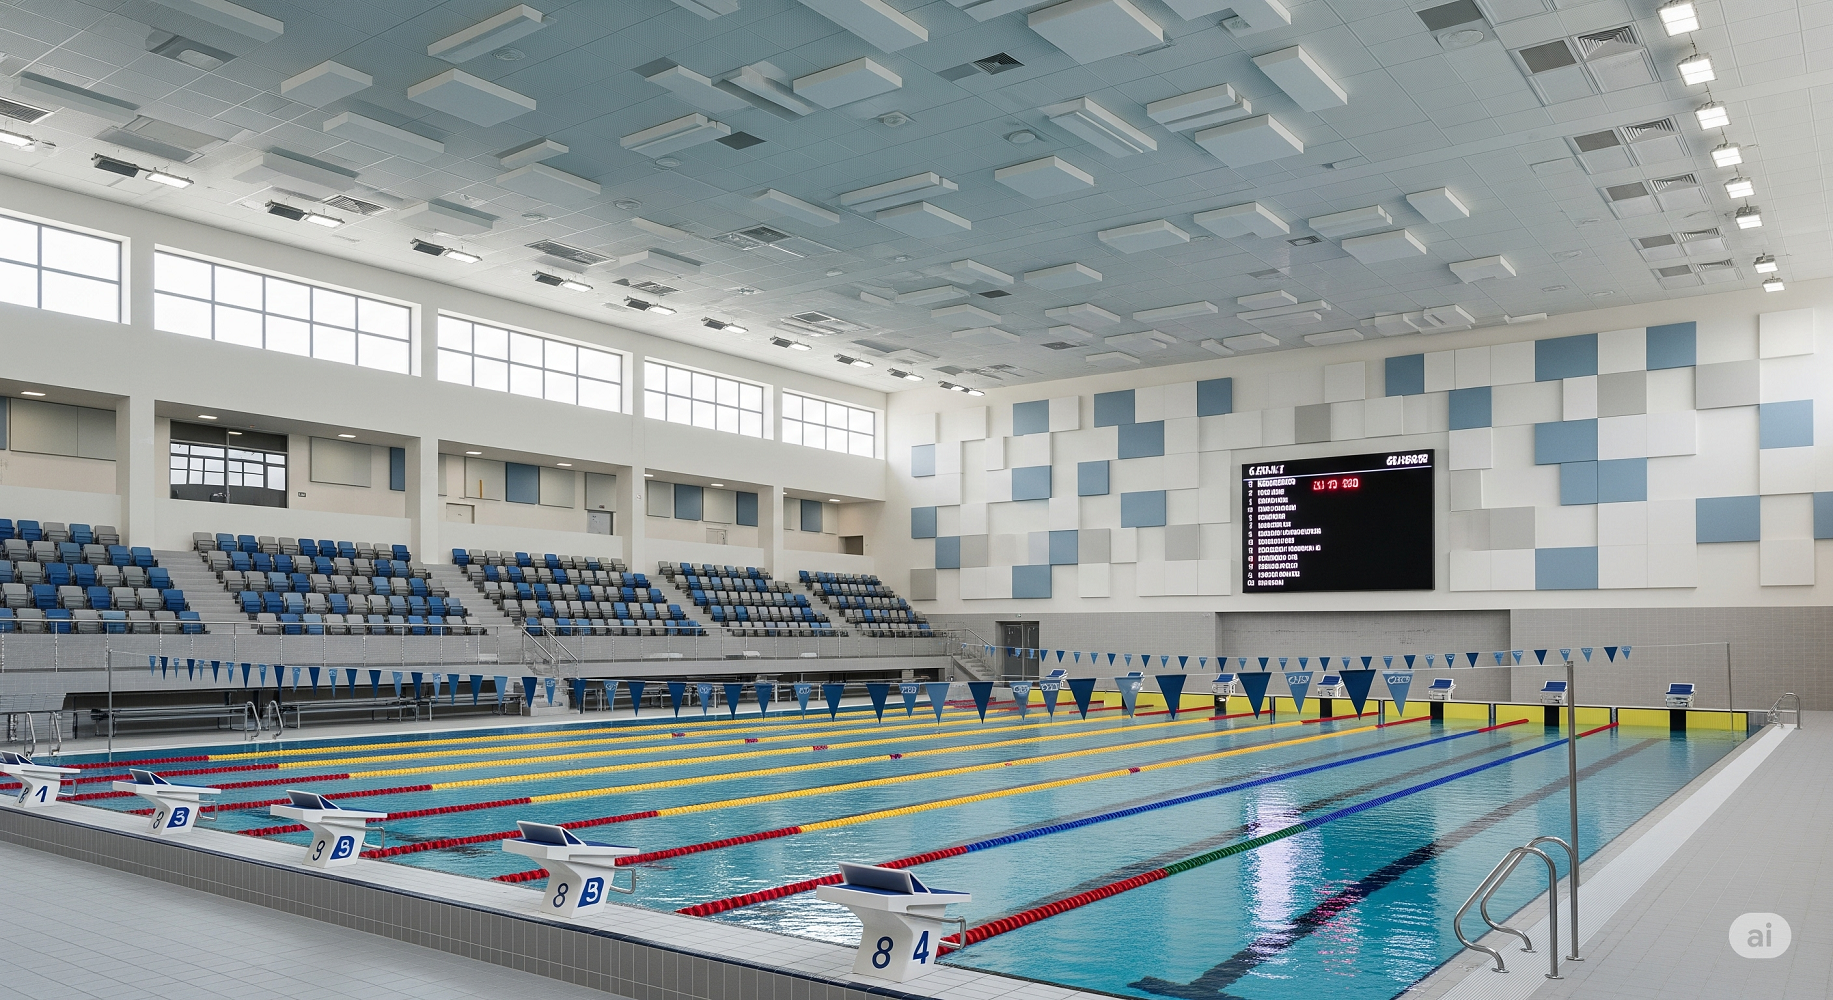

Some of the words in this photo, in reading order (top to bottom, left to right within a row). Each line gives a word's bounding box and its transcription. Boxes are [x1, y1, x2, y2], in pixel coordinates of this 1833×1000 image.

[35, 785, 48, 803] 1
[552, 882, 569, 908] 8
[871, 935, 894, 970] 8
[912, 930, 930, 965] 4
